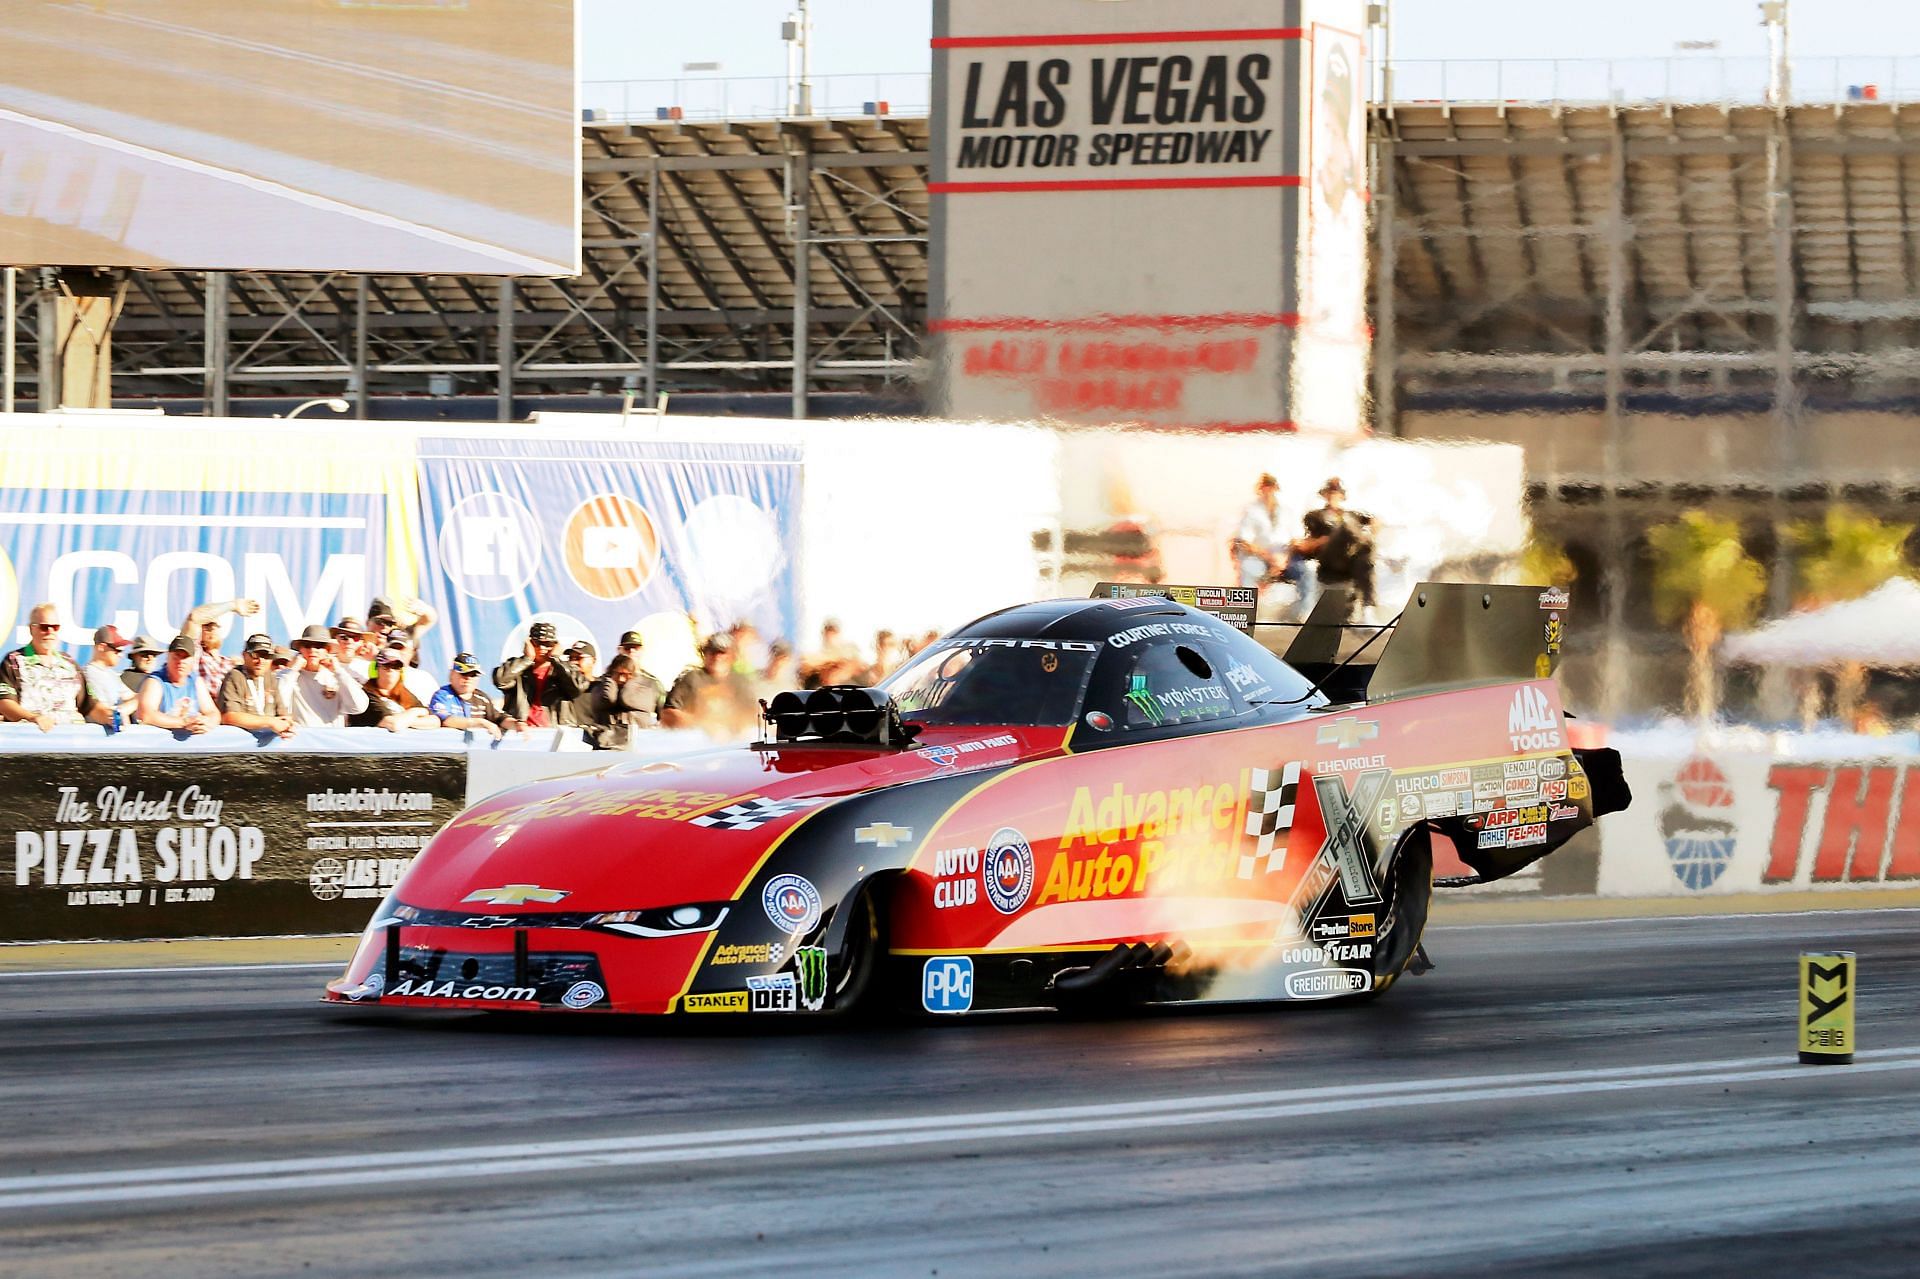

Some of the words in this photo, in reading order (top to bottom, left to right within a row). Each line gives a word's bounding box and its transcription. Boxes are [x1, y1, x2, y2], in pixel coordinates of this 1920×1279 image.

[961, 58, 1071, 128] LAS
[1091, 53, 1270, 125] VEGAS
[957, 134, 1080, 169] MOTOR
[1089, 129, 1271, 167] SPEEDWAY
[1197, 588, 1222, 598] LINCOLN
[1227, 590, 1253, 602] JESEL
[1220, 613, 1247, 621] STANDARD
[1108, 623, 1172, 649] COURTNEY
[1170, 623, 1212, 638] FORCE
[1225, 664, 1265, 692] PEAK
[1508, 685, 1557, 733] MAC
[957, 740, 984, 753] AUTO
[982, 735, 1018, 749] PARTS
[1509, 731, 1560, 751] TOOLS
[1317, 755, 1386, 773] CHEVROLET
[1504, 762, 1536, 773] VENOLIA
[1395, 775, 1440, 793] HURCO
[1441, 771, 1469, 786] SIMPSON
[1480, 782, 1503, 791] ACTION
[1571, 782, 1585, 793] TMS
[1542, 782, 1566, 796] MSD
[56, 786, 92, 823] The
[97, 785, 173, 821] Naked
[177, 785, 224, 827] City
[1058, 782, 1234, 849] Advance
[1487, 811, 1519, 827] ARP
[1479, 830, 1504, 843] MAHLE
[1507, 824, 1546, 840] FEL-PRO
[15, 829, 142, 886] PIZZA
[155, 826, 265, 882] SHOP
[934, 847, 979, 878] AUTO
[345, 859, 378, 887] LAS
[998, 858, 1020, 879] AAA
[1036, 846, 1133, 905] Auto
[67, 891, 87, 906] LAS
[165, 888, 185, 902] EST.
[186, 887, 215, 901] 2009
[781, 894, 806, 910] AAA
[934, 878, 977, 908] CLUB
[1321, 923, 1349, 936] Parker
[1350, 922, 1373, 933] Store
[717, 944, 766, 955] Advance
[711, 954, 737, 965] Auto
[738, 953, 764, 964] Parts
[388, 980, 536, 1000] AAA.com
[926, 959, 971, 1006] PPG
[1293, 974, 1362, 992] FREIGHTLINER
[689, 996, 744, 1007] STANLEY
[755, 990, 793, 1009] DEF
